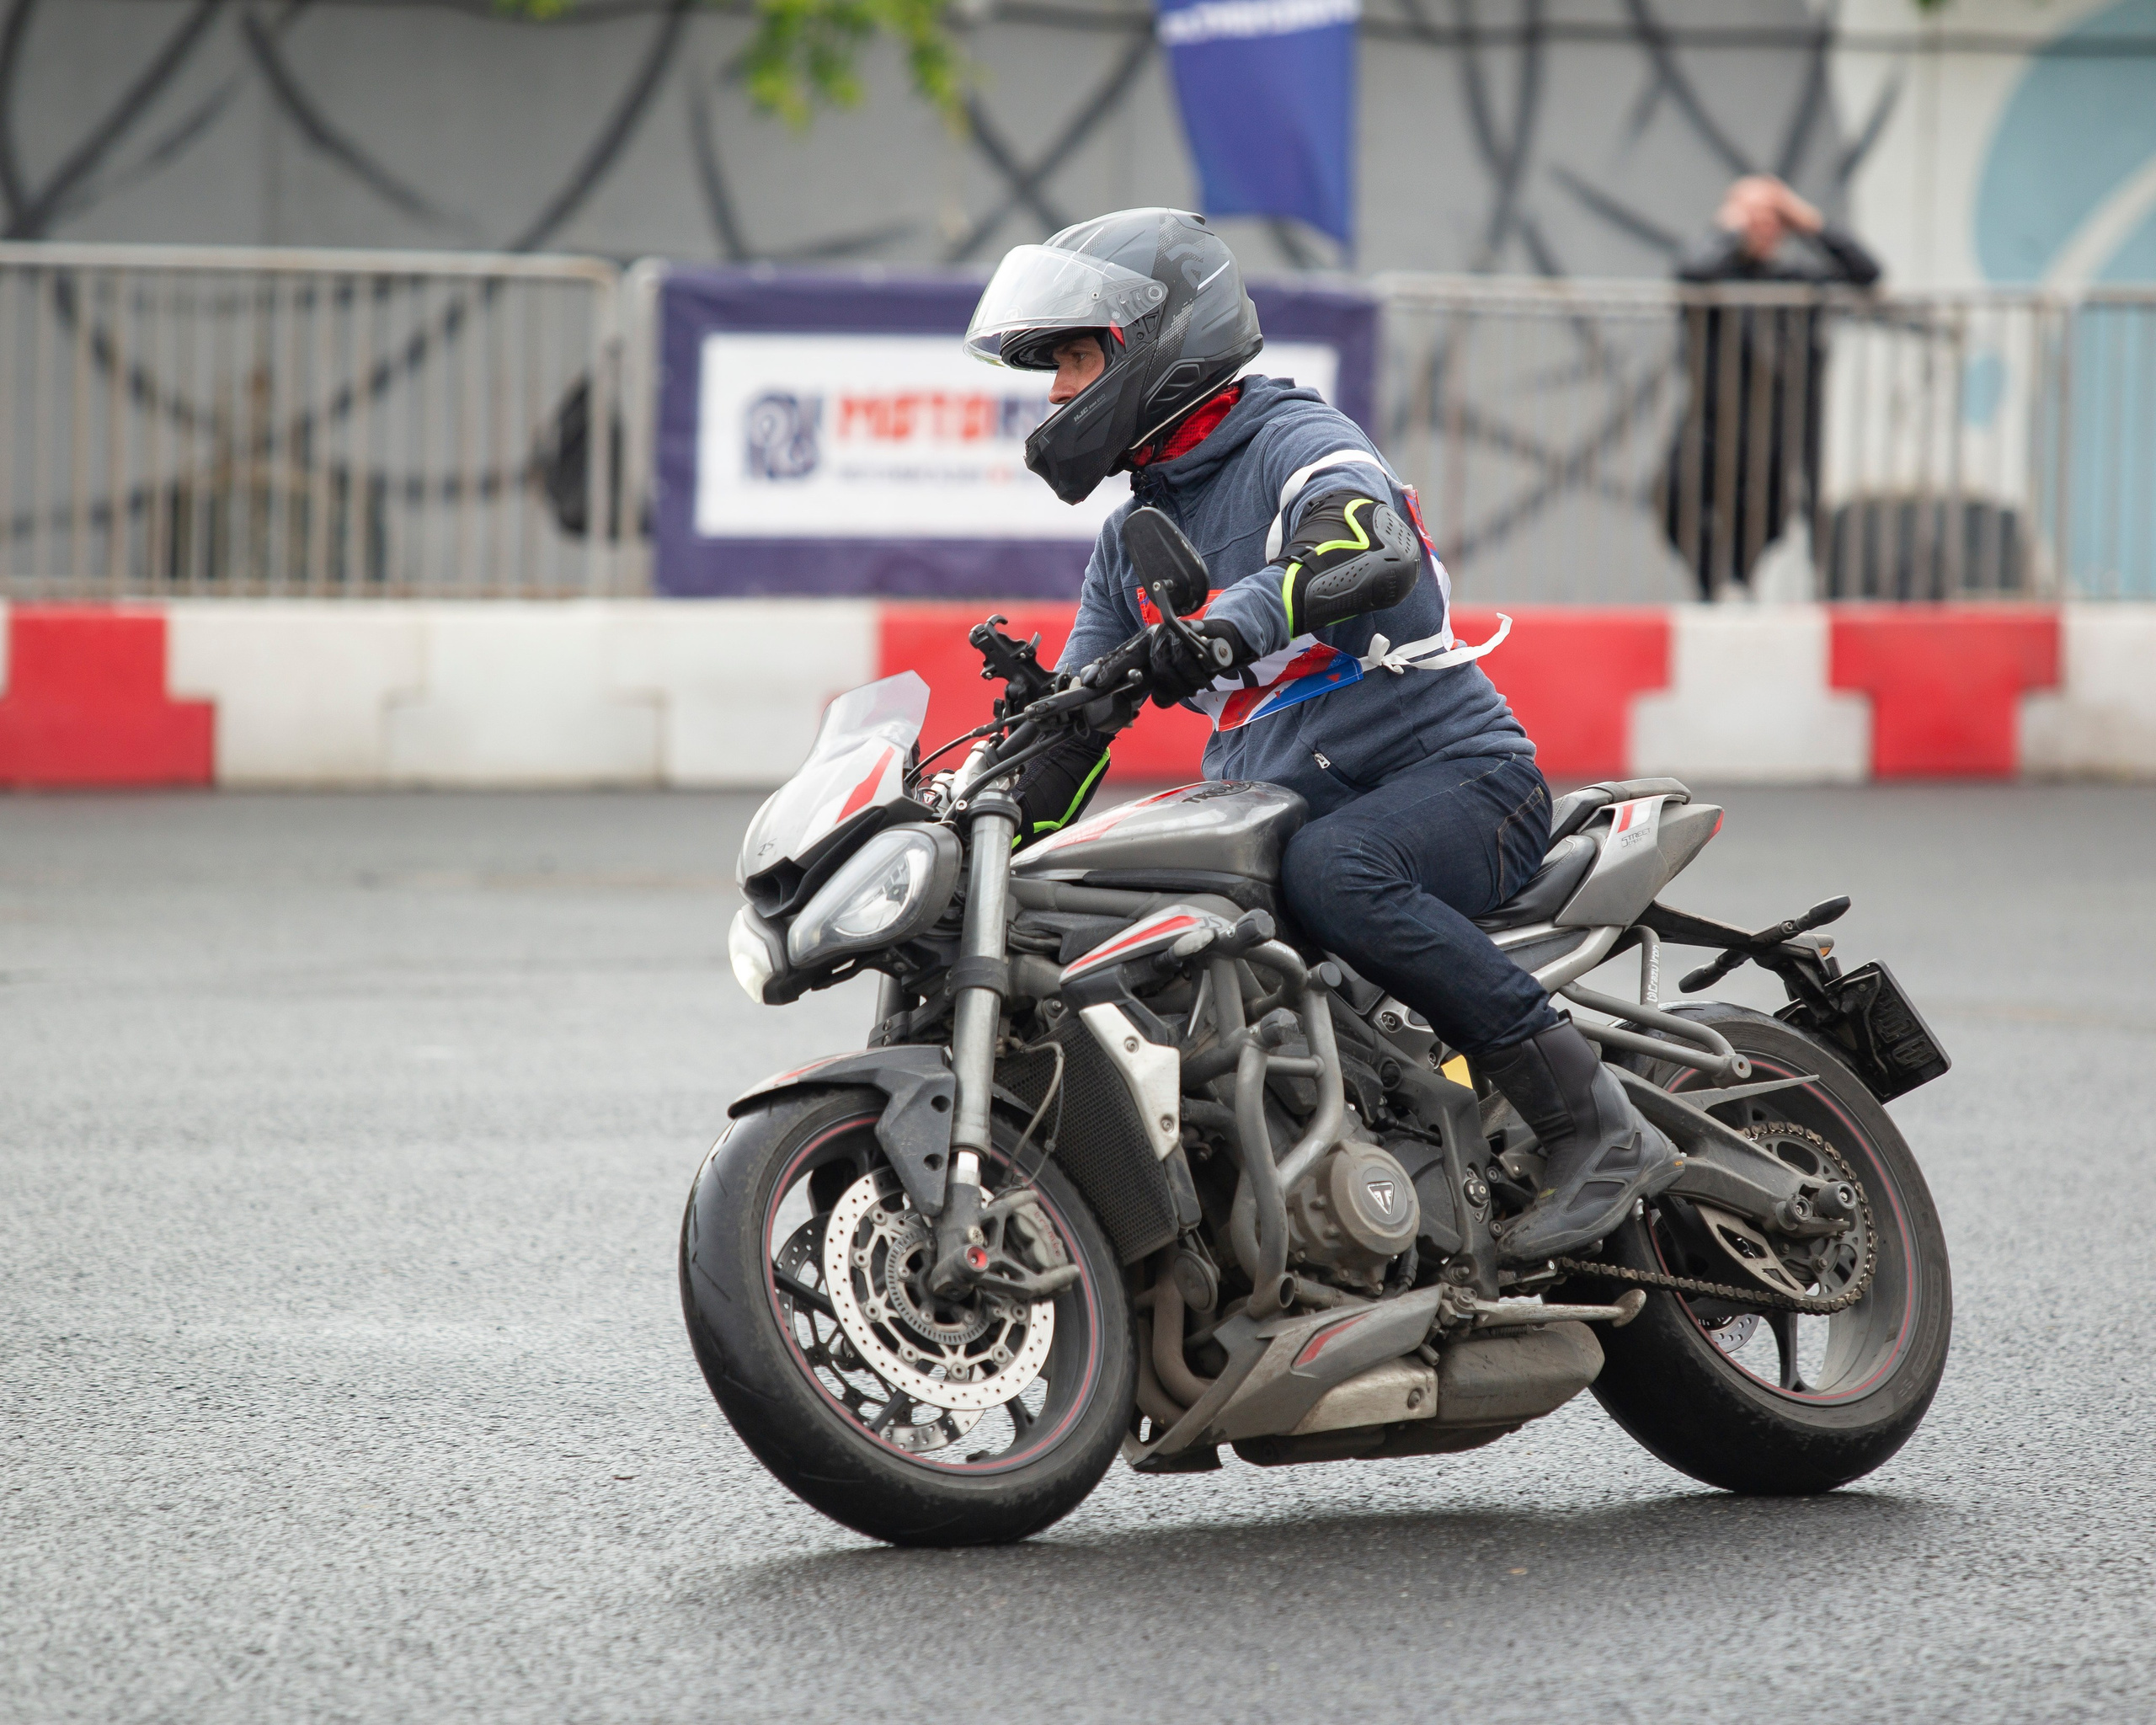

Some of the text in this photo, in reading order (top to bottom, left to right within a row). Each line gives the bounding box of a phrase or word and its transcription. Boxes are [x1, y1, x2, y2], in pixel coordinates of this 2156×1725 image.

[1073, 406, 1089, 422] HJC
[1648, 944, 1660, 993] Crazy Iron
